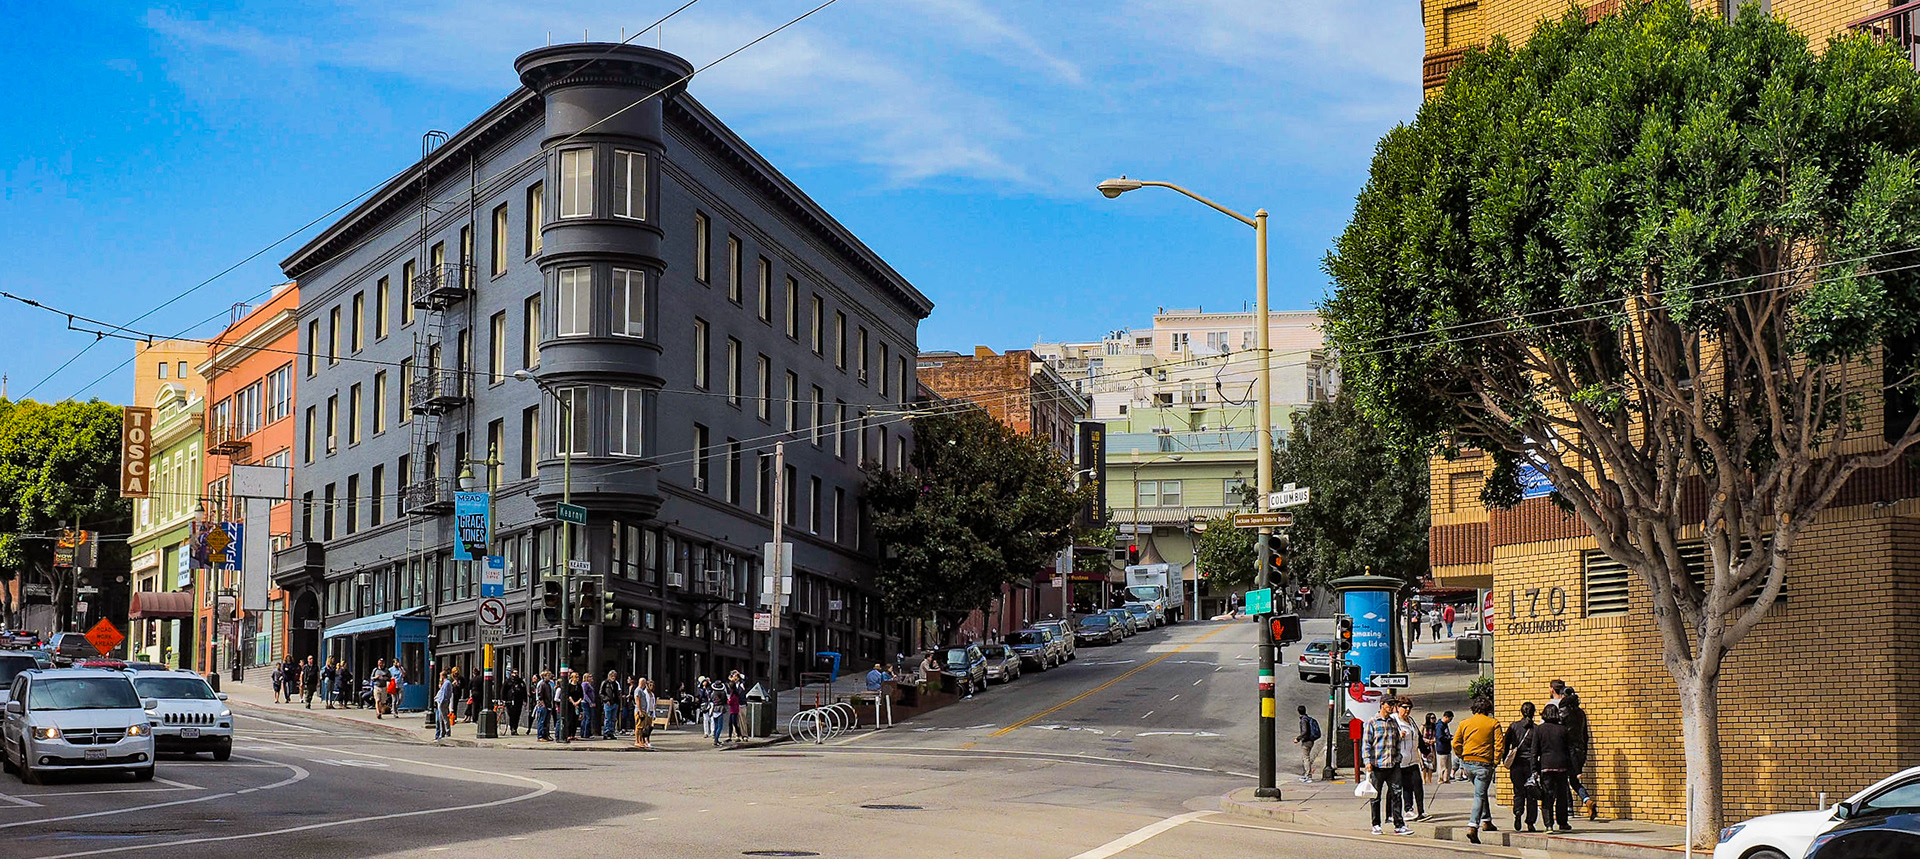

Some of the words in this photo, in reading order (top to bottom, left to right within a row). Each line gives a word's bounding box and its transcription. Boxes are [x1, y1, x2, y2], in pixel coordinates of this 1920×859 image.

[127, 412, 146, 492] TOSCA
[1271, 491, 1308, 506] COLUMBUS
[460, 515, 485, 529] GRACE
[560, 507, 583, 523] Kearny
[461, 529, 485, 542] JONES
[225, 522, 237, 571] SFJAZZ
[1508, 587, 1566, 619] 170
[1352, 630, 1381, 639] amazing
[1508, 619, 1566, 635] COLUMBUS
